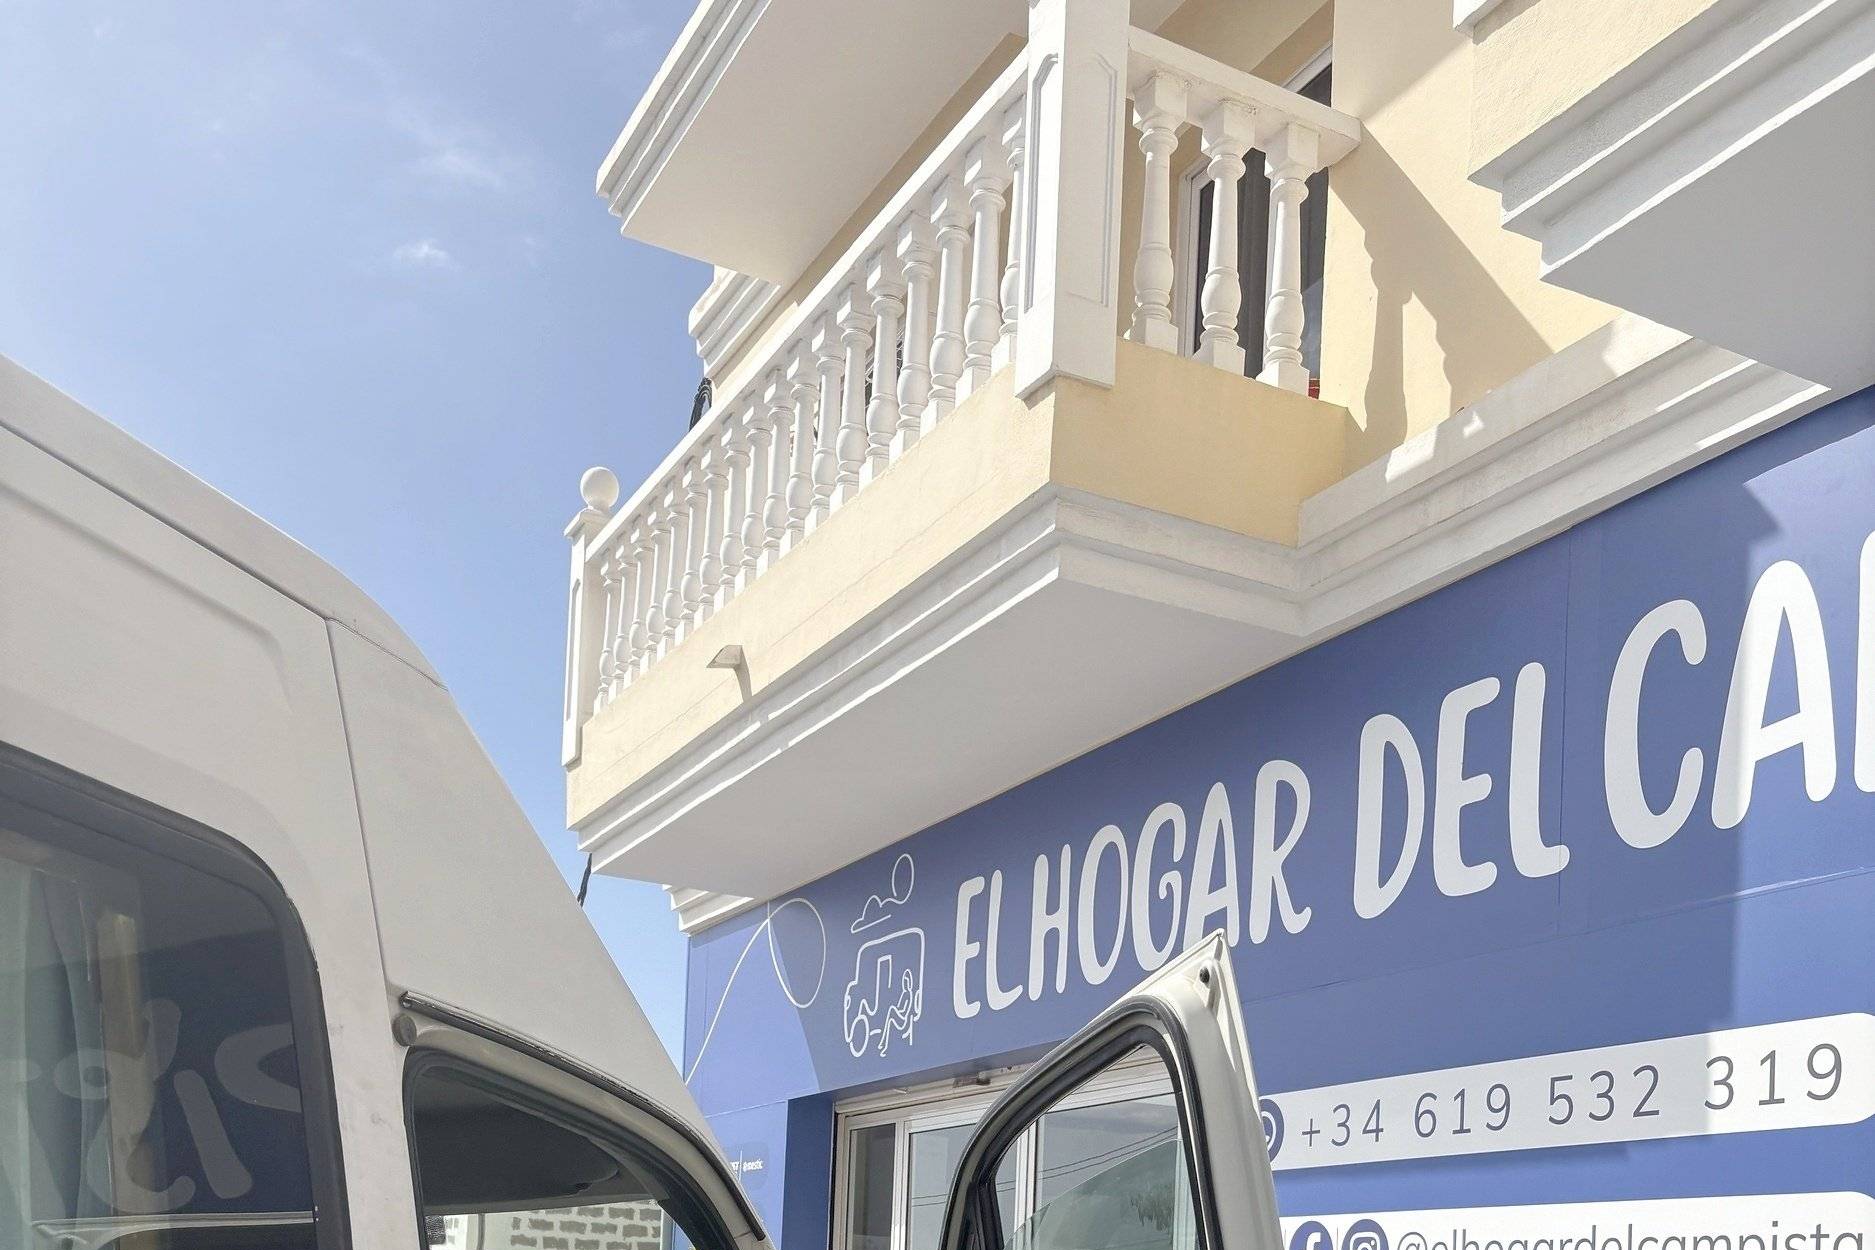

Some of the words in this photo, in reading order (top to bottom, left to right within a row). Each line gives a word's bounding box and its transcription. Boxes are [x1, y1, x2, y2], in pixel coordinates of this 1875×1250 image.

[953, 870, 1023, 1018] EL
[1028, 760, 1312, 1001] HOGAR
[1354, 662, 1570, 919] DEL
[1604, 528, 1875, 849] CA
[1301, 1099, 1384, 1147] +34
[1414, 1083, 1511, 1138] 619
[1548, 1064, 1660, 1125] 532
[1704, 1043, 1842, 1110] 319
